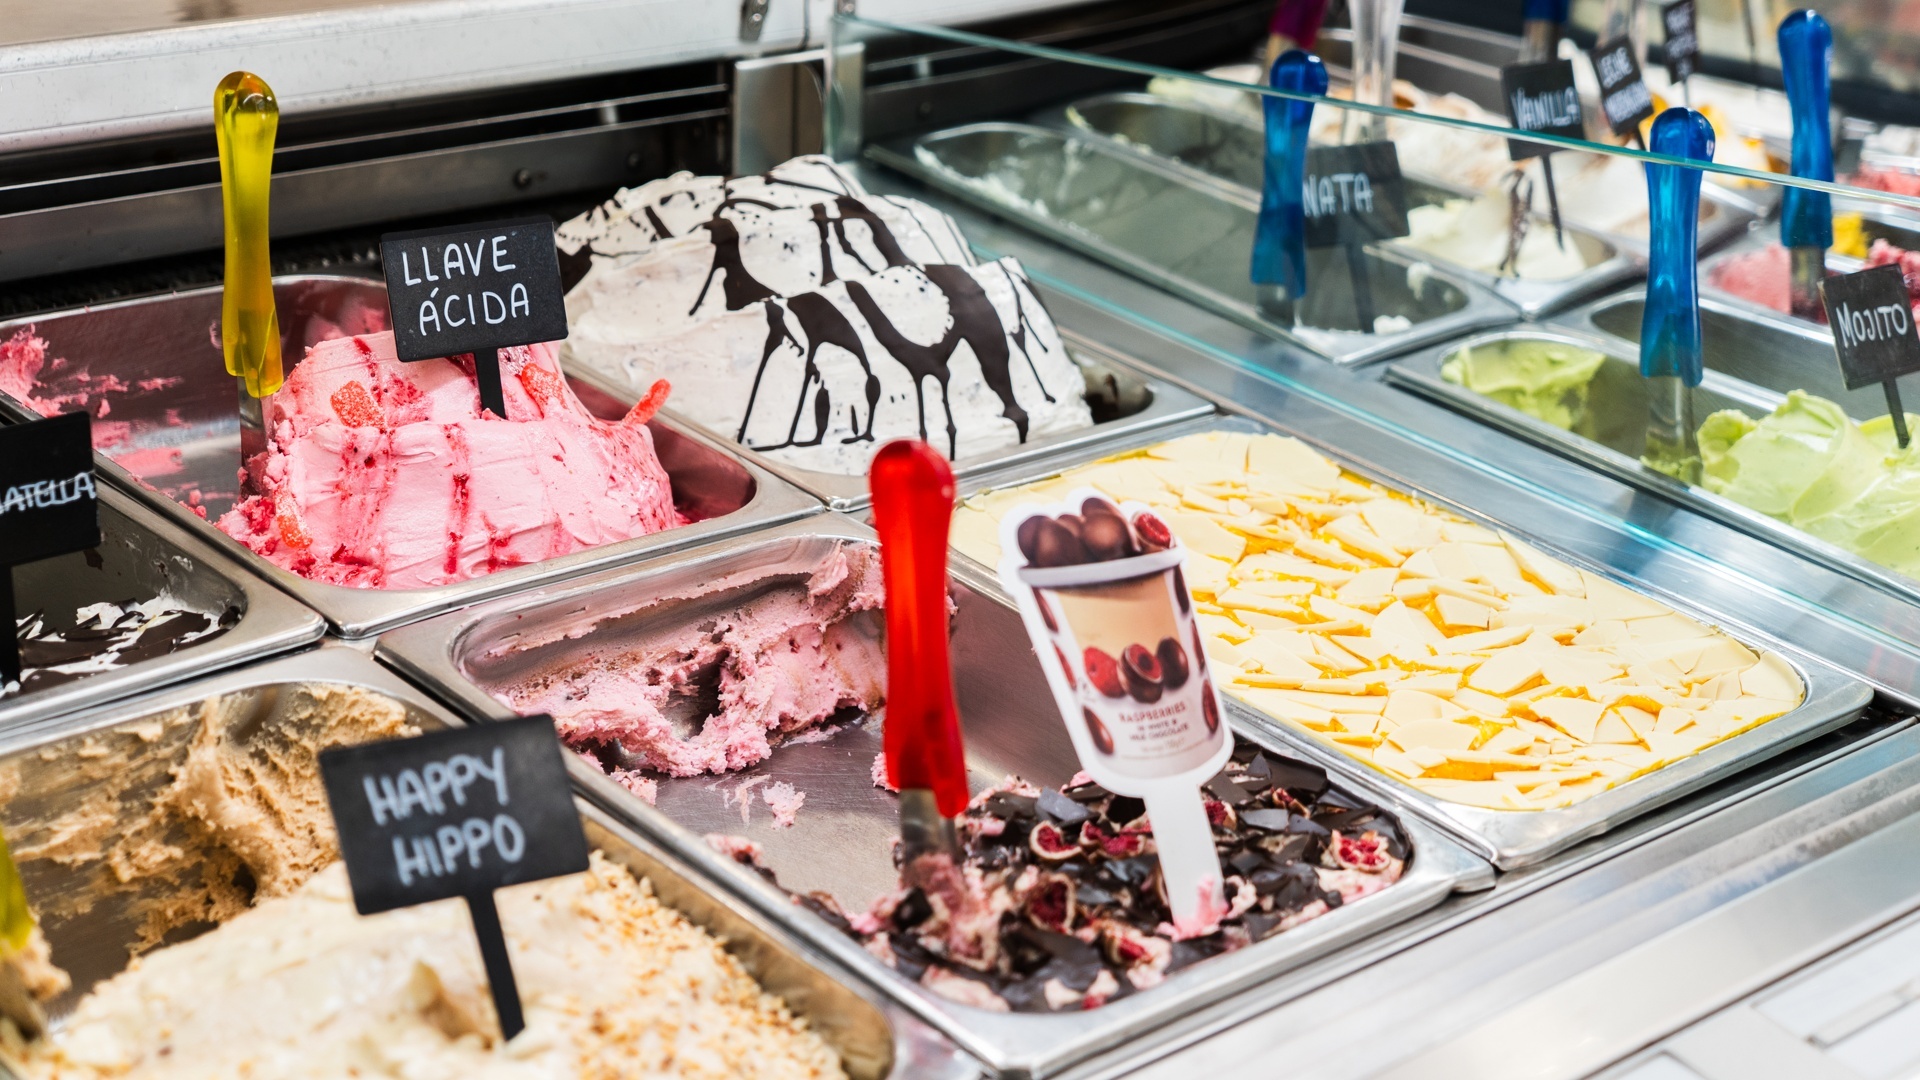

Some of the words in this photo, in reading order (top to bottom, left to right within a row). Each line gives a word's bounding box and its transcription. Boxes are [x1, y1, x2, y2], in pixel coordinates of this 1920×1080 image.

[1510, 87, 1580, 130] VANILLA
[1302, 173, 1374, 218] NATA
[402, 236, 516, 286] LLAVE
[419, 283, 529, 336] ÁCIDA
[1836, 302, 1908, 348] MOJITO
[0, 472, 97, 515] ATELLA
[1118, 701, 1186, 723] RASPBERRIES
[362, 745, 510, 826] HAPPY
[392, 813, 526, 886] HIPPO
